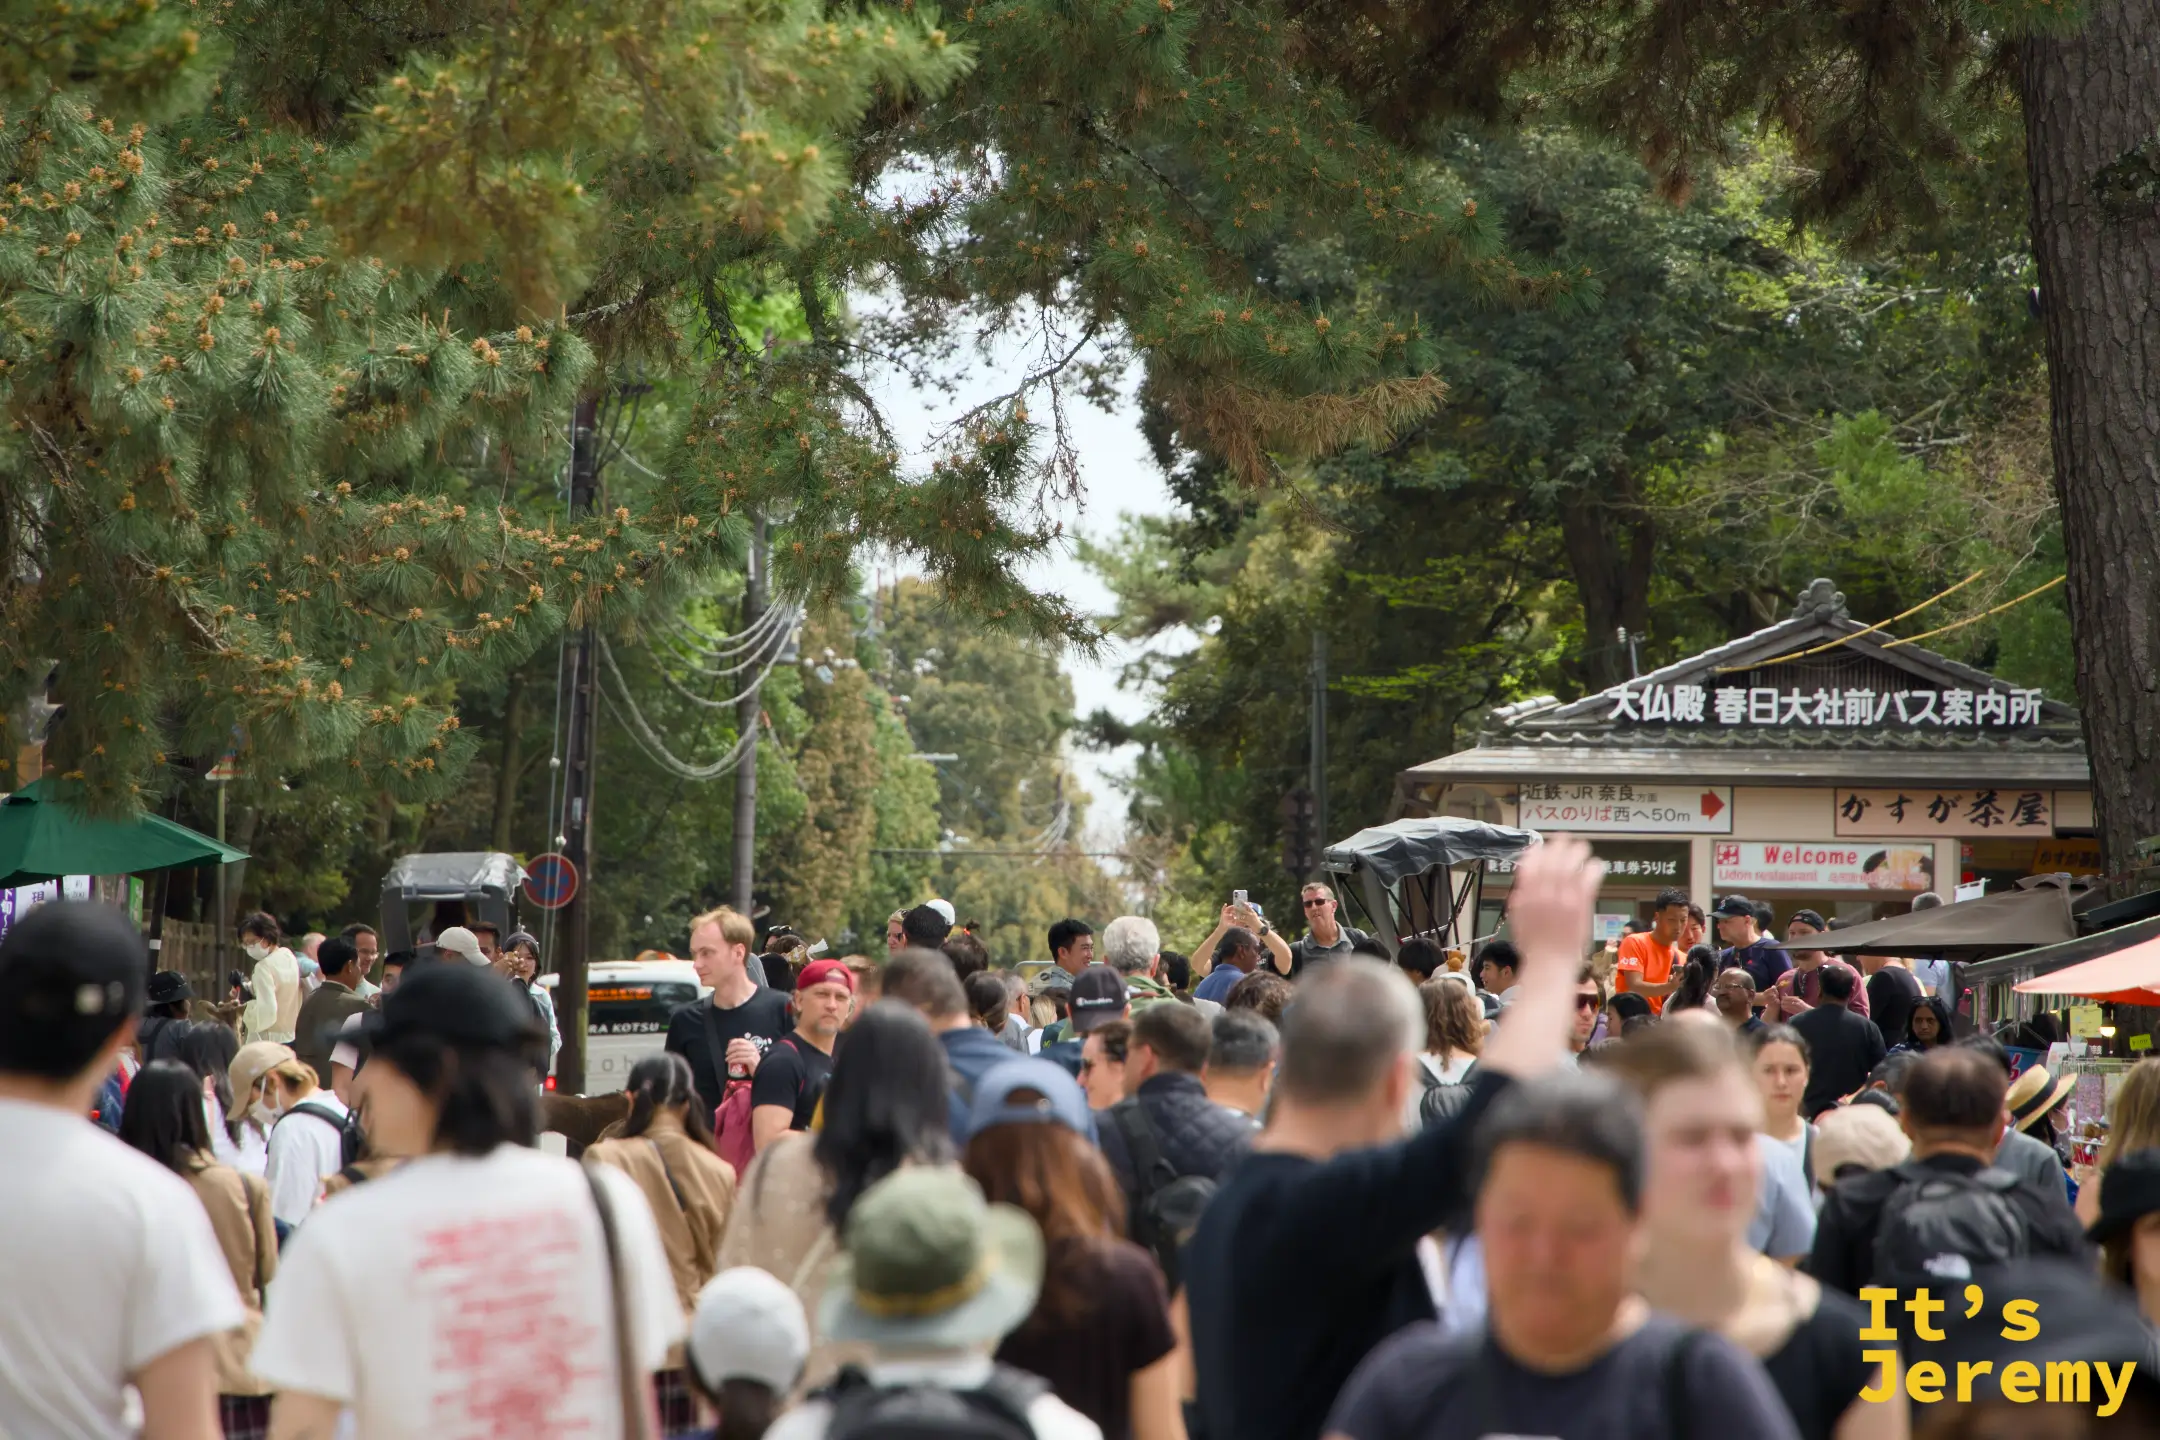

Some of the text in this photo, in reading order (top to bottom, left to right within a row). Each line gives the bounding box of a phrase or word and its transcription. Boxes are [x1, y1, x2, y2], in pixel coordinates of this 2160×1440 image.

[1608, 684, 2043, 726] 大仏殿 春日大社前バス案内所
[1524, 806, 1690, 822] バスのりば西へ50m
[1840, 790, 2049, 828] かすが茶屋
[1764, 845, 1858, 865] Welcome
[1718, 868, 1752, 881] Udon
[589, 1021, 660, 1034] RA KOTSU
